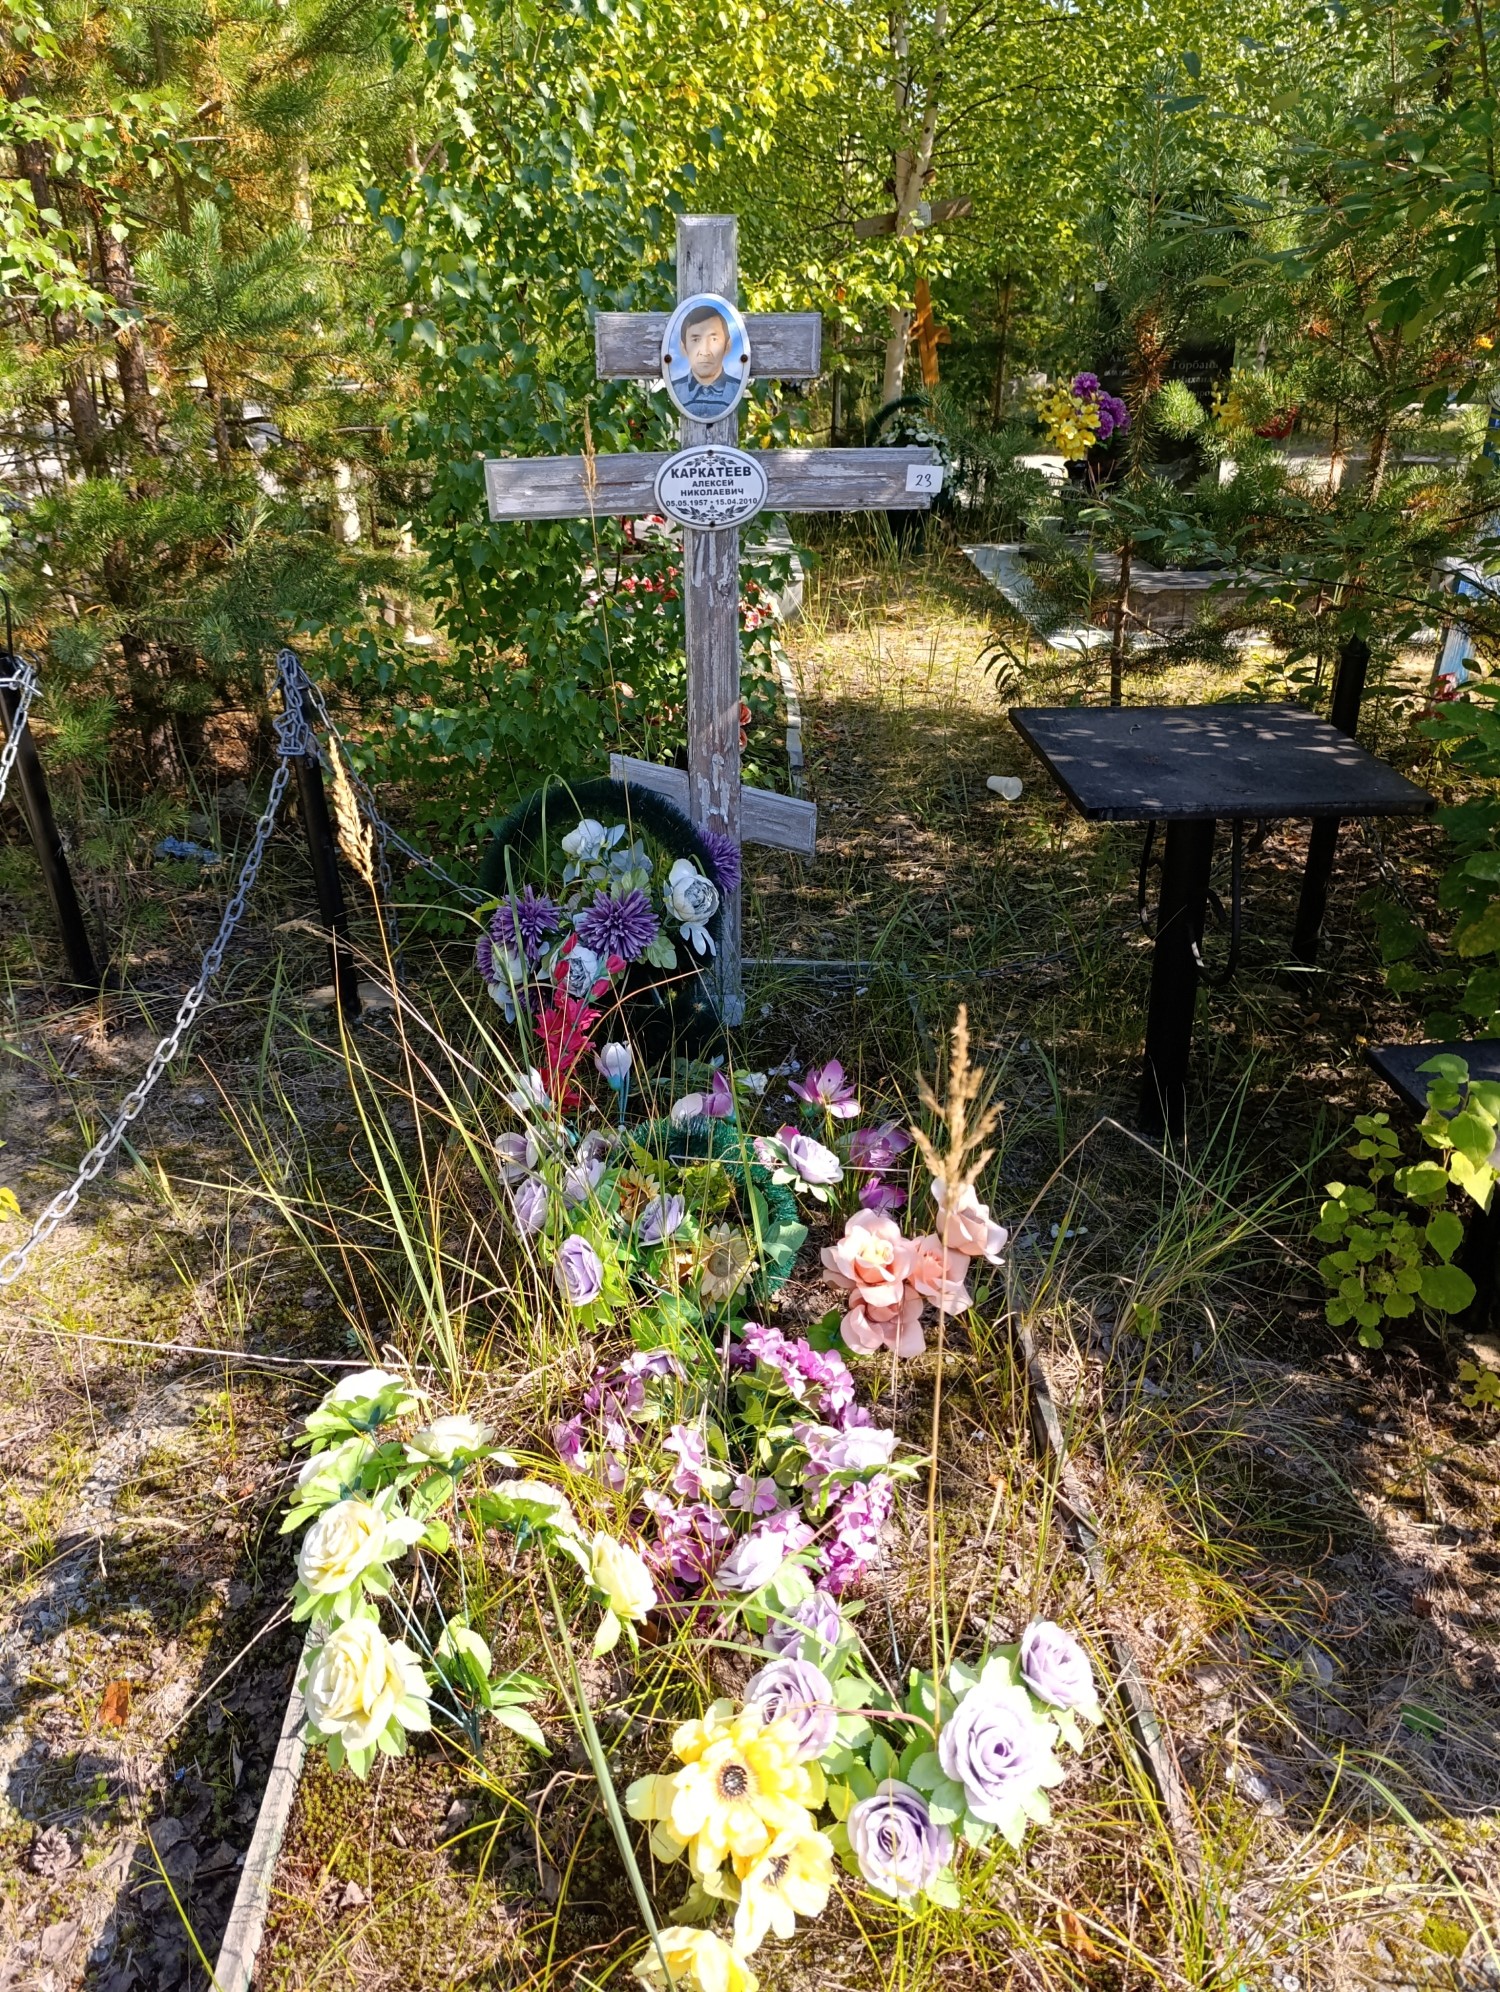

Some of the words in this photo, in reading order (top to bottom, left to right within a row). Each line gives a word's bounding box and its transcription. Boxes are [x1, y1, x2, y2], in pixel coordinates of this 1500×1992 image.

[671, 466, 752, 479] КАРКАТЕЕВ
[692, 479, 734, 488] АЛЕКСЕЙ
[915, 473, 932, 488] 23
[680, 488, 744, 497] НИКОЛАЕВИЧ
[665, 499, 708, 507] 05.05.1957
[715, 497, 758, 506] 15.04.2010
